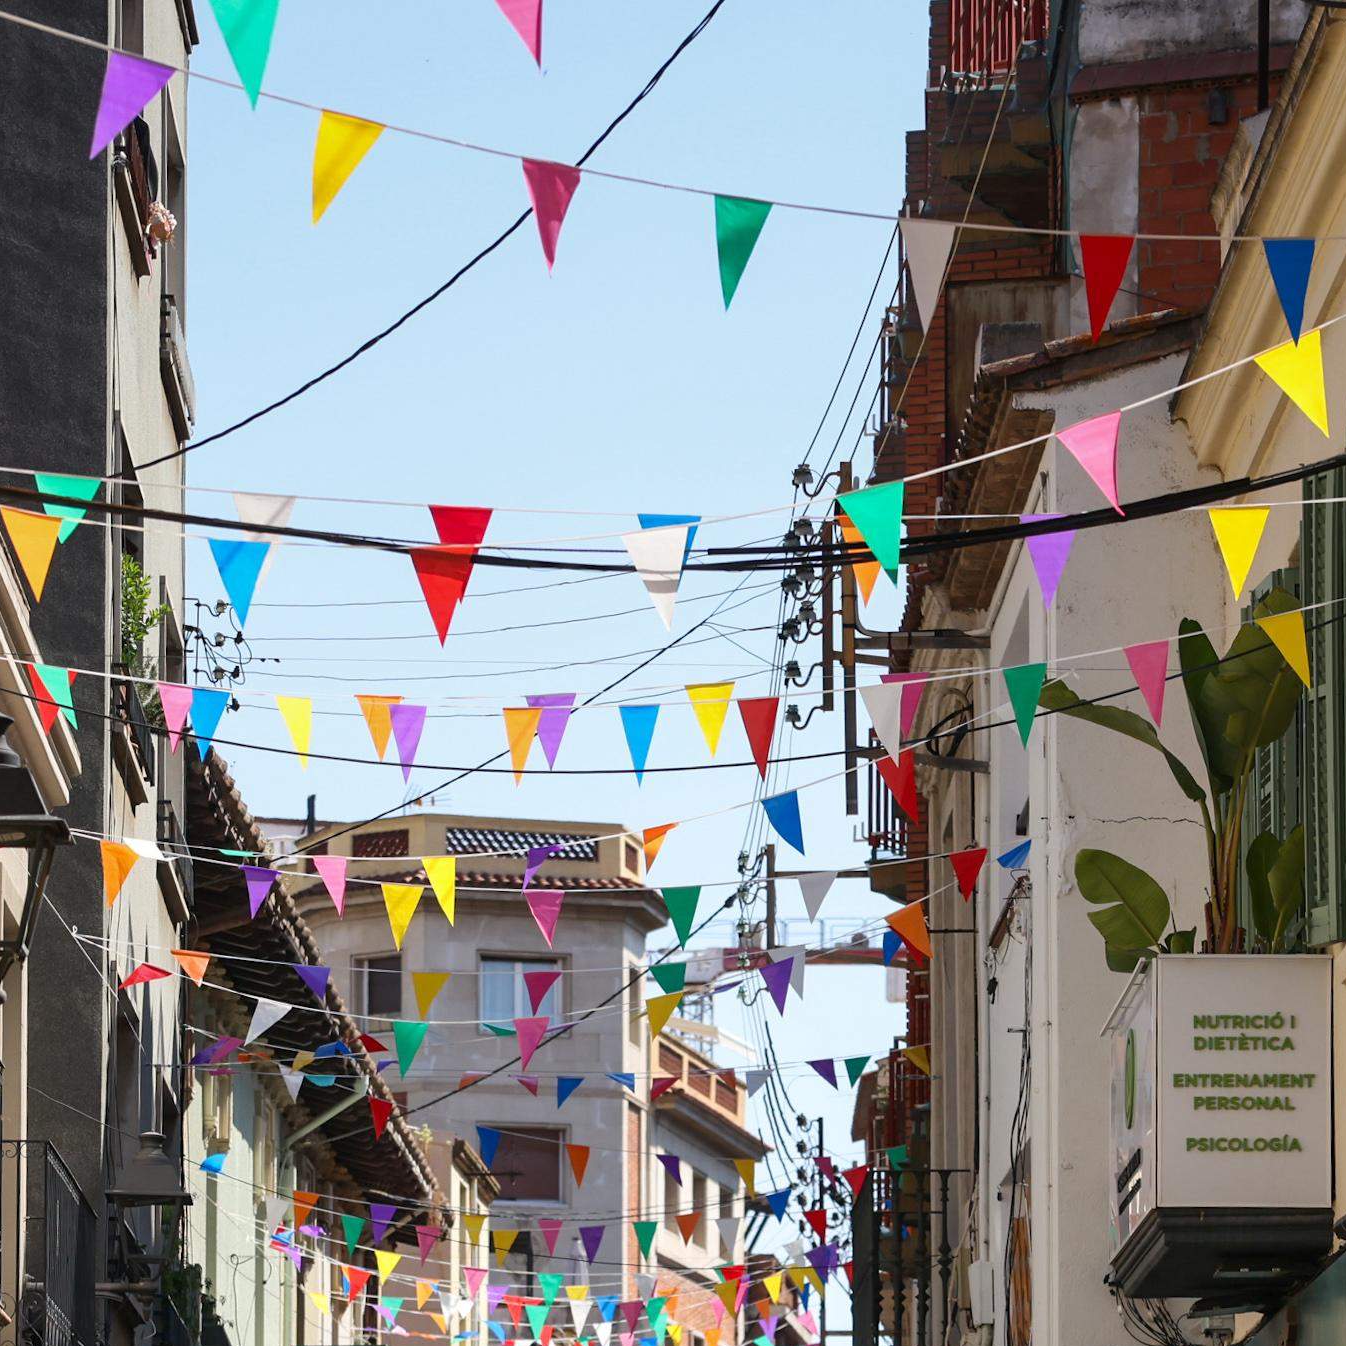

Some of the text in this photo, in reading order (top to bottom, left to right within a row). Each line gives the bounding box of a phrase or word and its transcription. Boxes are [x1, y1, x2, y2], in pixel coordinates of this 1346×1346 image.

[1193, 1012, 1296, 1029] NUTRICIÓ I
[1193, 1034, 1294, 1051] DIETÈTICA
[1173, 1073, 1316, 1088] ENTRENAMENT
[1193, 1096, 1296, 1110] PERSONAL
[1185, 1135, 1302, 1151] PSICOLOGÍA
